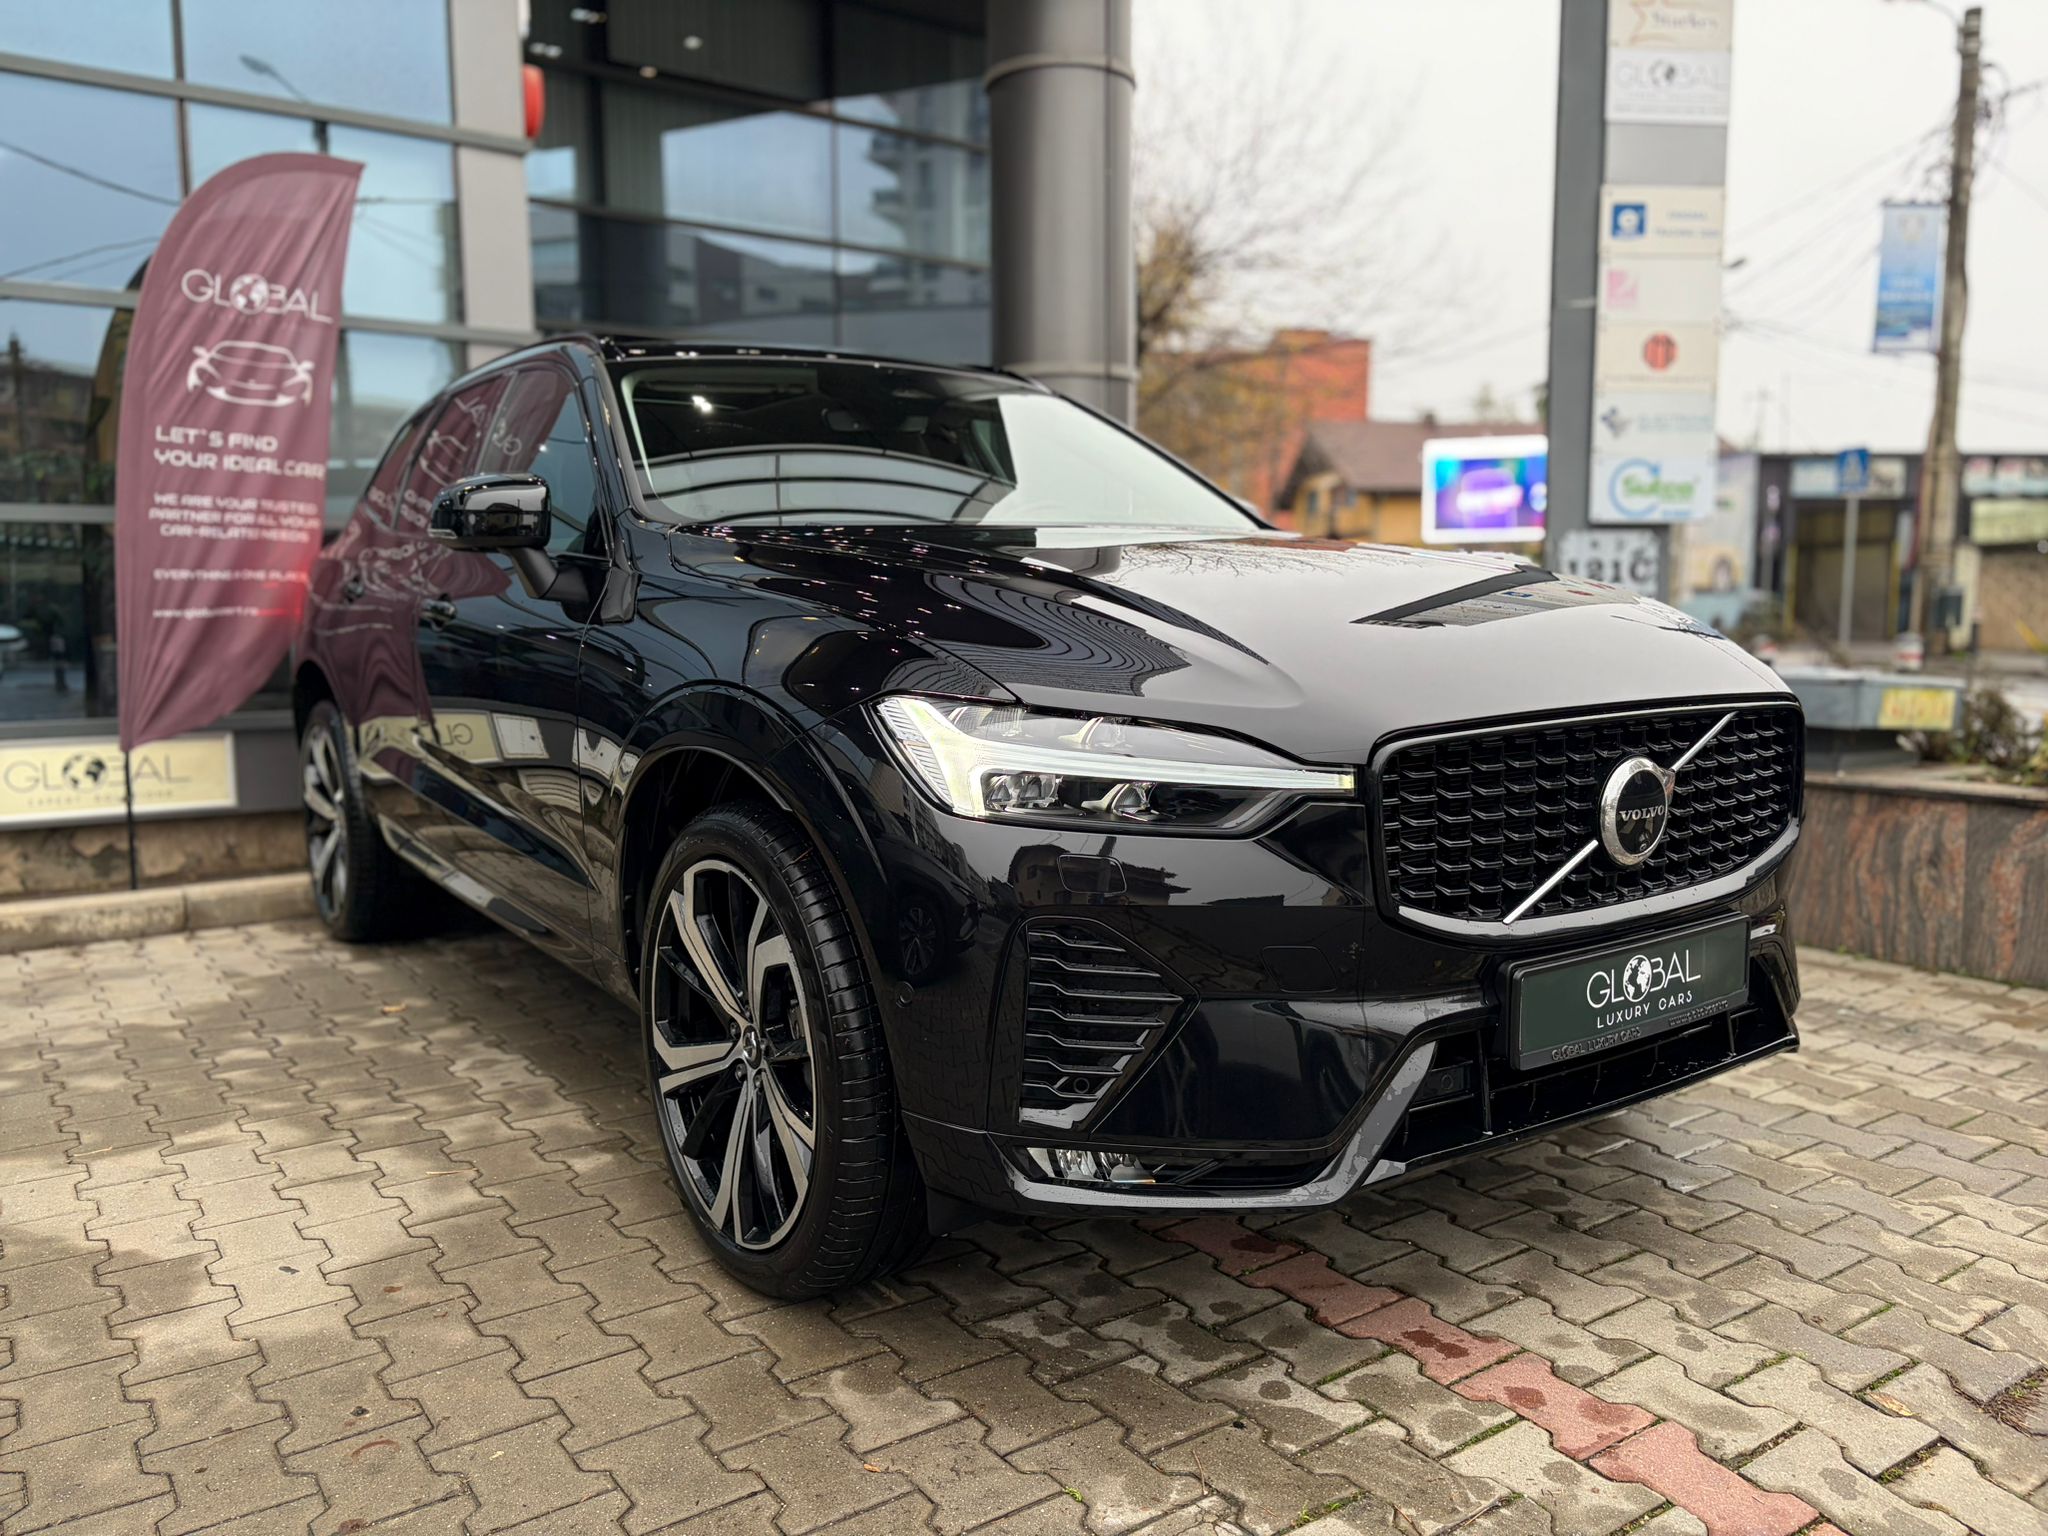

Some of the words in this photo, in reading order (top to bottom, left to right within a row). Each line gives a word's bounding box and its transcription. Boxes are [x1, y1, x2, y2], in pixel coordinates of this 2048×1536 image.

[181, 268, 334, 325] GLOBAL
[228, 432, 278, 453] FIND
[153, 448, 218, 470] YOUR
[222, 454, 282, 476] IDEAL
[283, 460, 327, 482] CAR
[149, 507, 221, 522] PARTNER
[223, 511, 256, 525] FOR
[153, 492, 178, 506] WE
[181, 495, 213, 509] ARE
[215, 497, 258, 511] YOUR
[1619, 804, 1665, 822] VOLVO
[1586, 949, 1702, 1009] GLOBAL
[1597, 1002, 1651, 1029] LUXURY
[1658, 990, 1693, 1012] CARS
[1551, 1042, 1585, 1062] GLOBAL
[1587, 1032, 1619, 1052] LUXURY
